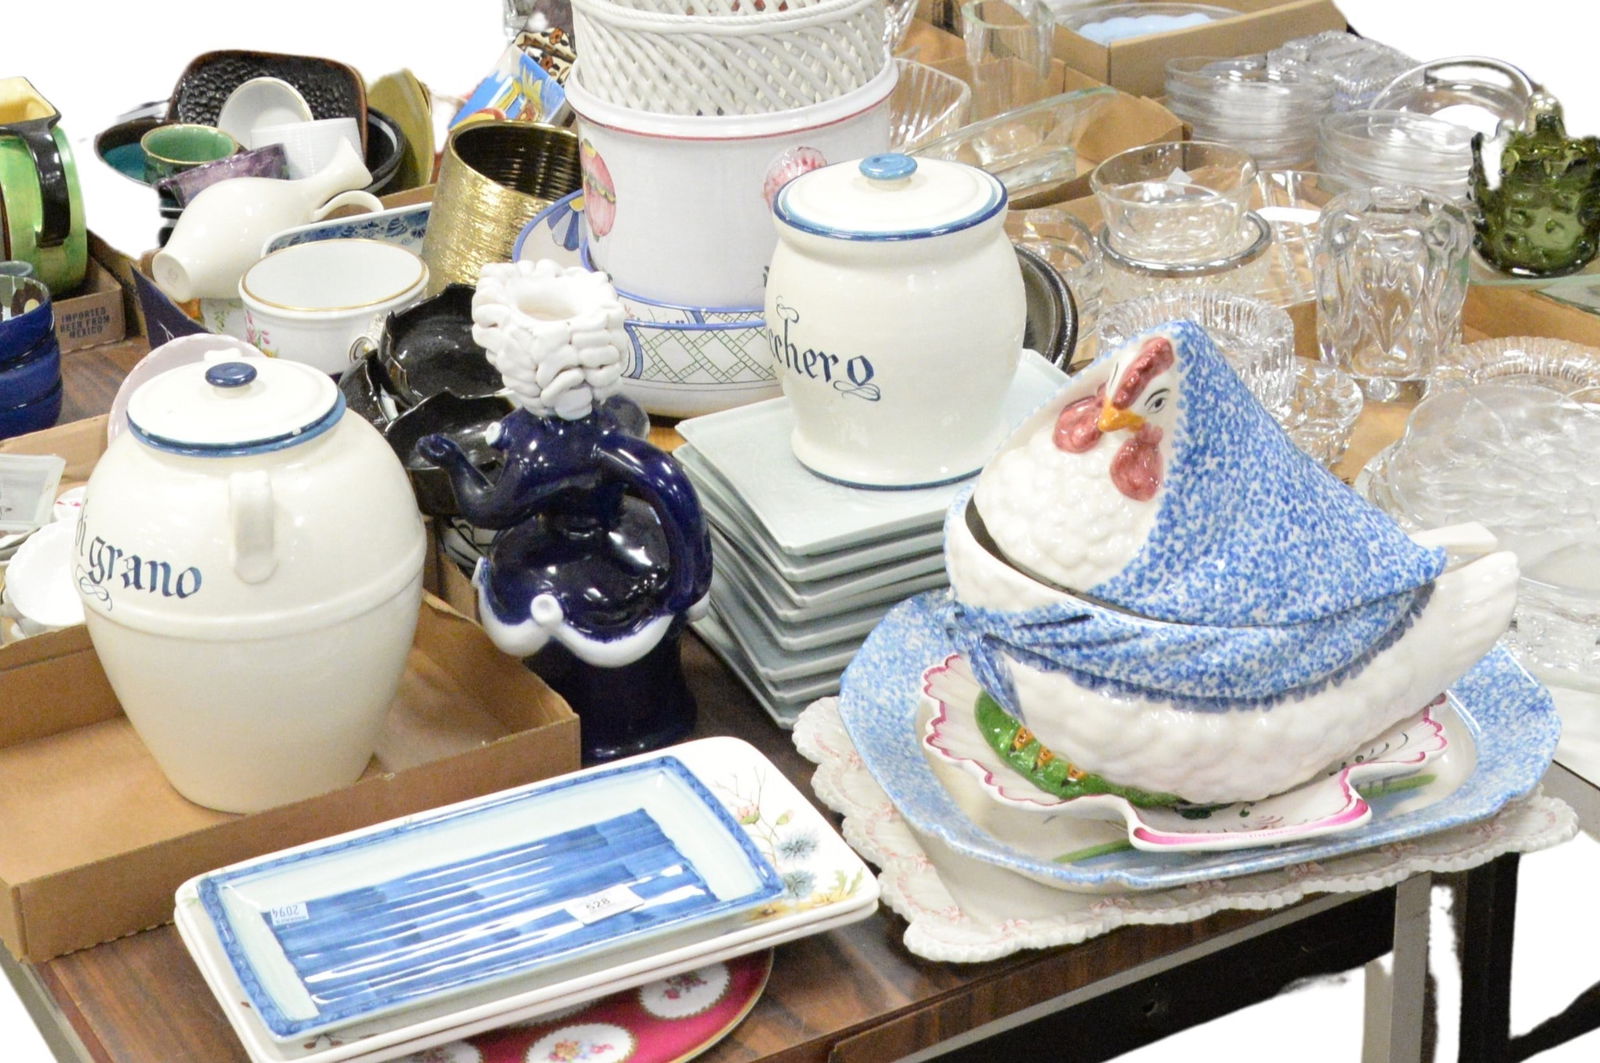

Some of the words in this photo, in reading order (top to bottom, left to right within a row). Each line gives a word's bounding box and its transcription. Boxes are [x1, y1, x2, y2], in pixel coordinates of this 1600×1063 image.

[60, 320, 82, 333] BEER
[86, 314, 110, 328] FROM
[61, 306, 106, 323] IMPORTED
[69, 324, 103, 339] MEXICO
[88, 535, 203, 600] grano
